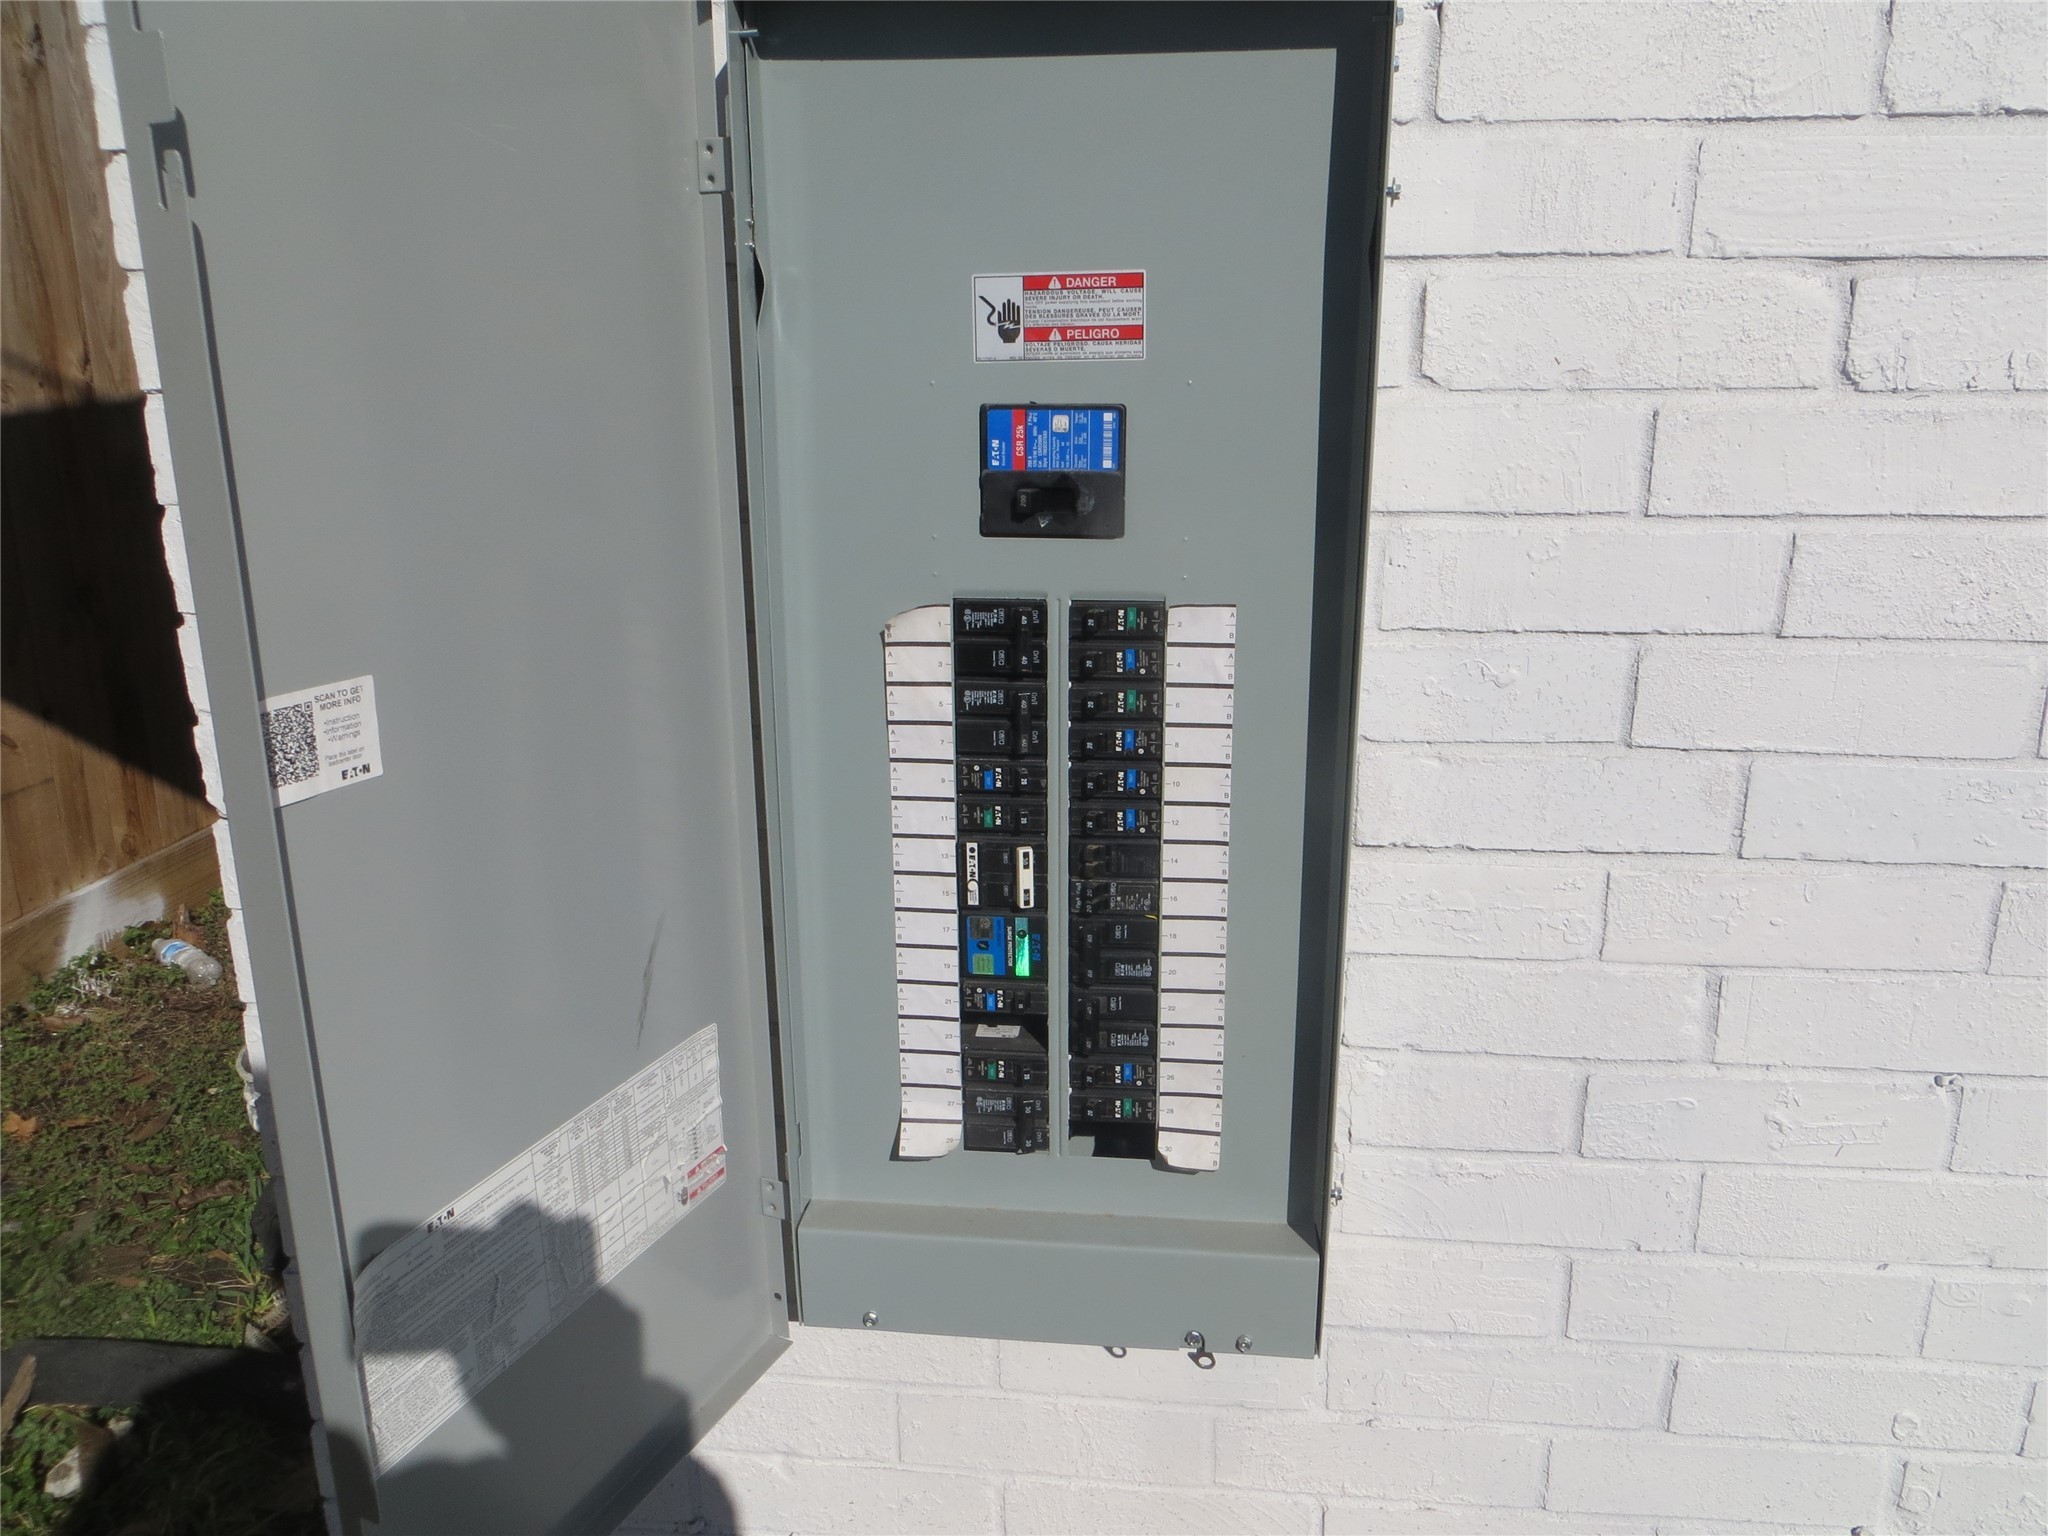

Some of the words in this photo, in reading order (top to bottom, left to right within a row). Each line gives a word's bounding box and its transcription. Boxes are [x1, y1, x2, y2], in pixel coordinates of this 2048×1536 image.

[1066, 276, 1117, 288] DANGER
[1066, 328, 1120, 339] PELIGRO
[1016, 425, 1024, 439] 25k
[1016, 440, 1024, 457] CSR
[1020, 494, 1028, 507] 200
[1021, 615, 1028, 625] 40
[1087, 618, 1095, 626] 20
[1021, 656, 1028, 665] 40
[1086, 660, 1093, 668] 20
[314, 690, 336, 703] SCAN
[337, 689, 348, 699] TO
[350, 685, 363, 695] GET
[319, 700, 342, 711] MORE
[344, 695, 361, 706] INFO
[1087, 701, 1094, 709] 20
[1086, 888, 1093, 897] 20
[1086, 904, 1093, 913] 20
[1025, 1106, 1032, 1114] 30
[1087, 1109, 1094, 1117] 20
[1025, 1139, 1032, 1148] 30
